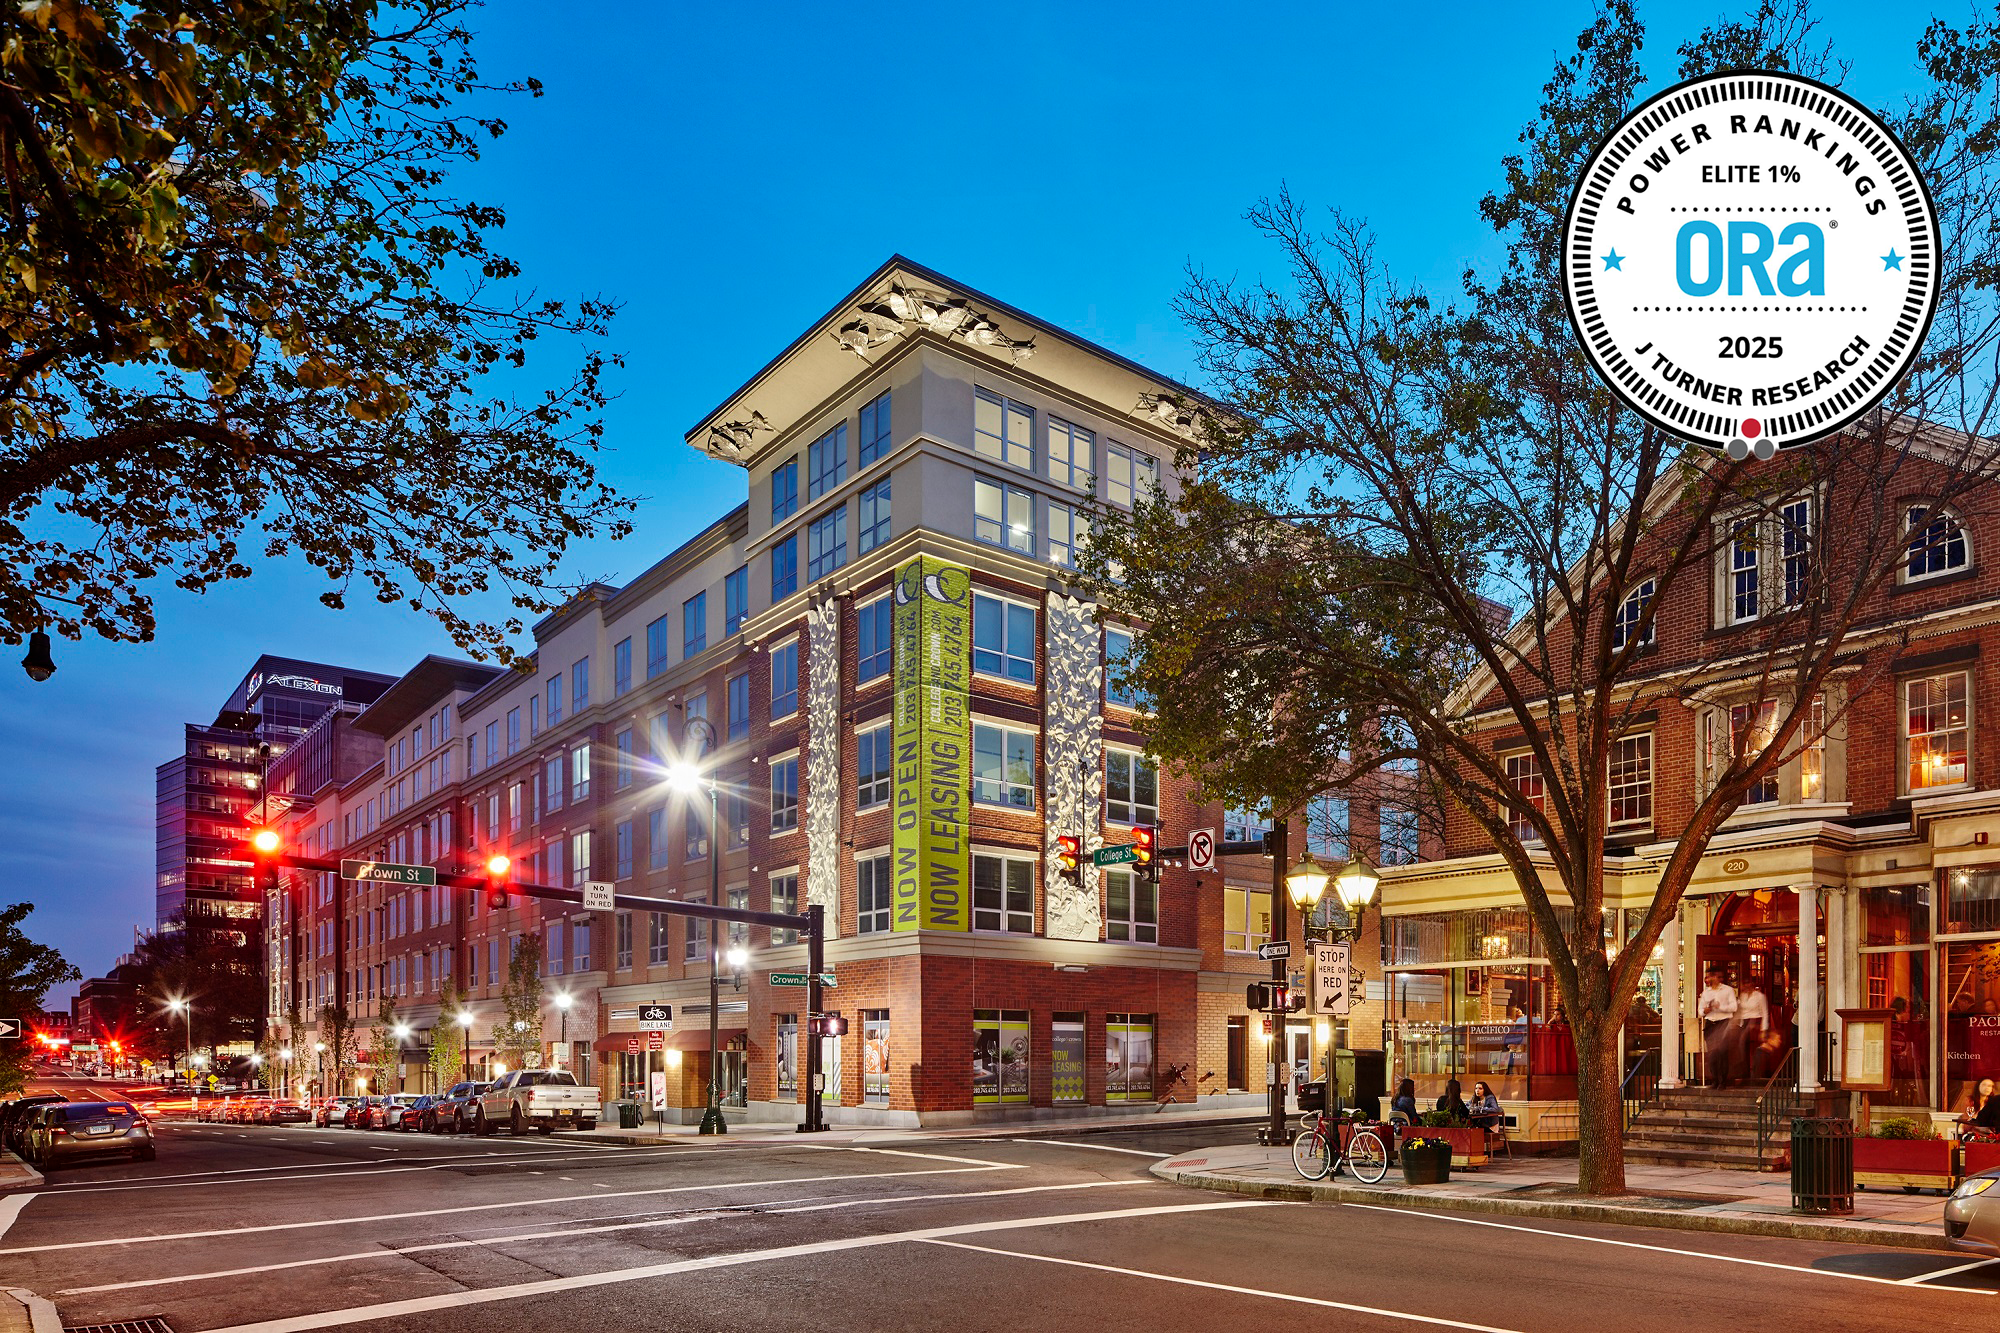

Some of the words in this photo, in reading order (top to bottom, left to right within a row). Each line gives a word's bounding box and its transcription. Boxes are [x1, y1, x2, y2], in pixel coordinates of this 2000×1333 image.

[905, 610, 917, 724] 203.745.4764
[930, 609, 942, 723] COLLEGEANDCROWN.COM
[943, 615, 963, 728] 203.745.4764
[897, 740, 917, 831] OPEN
[930, 741, 961, 855] LEASING
[1100, 850, 1123, 863] College
[1124, 846, 1132, 859] St
[359, 865, 402, 880] Crown
[406, 868, 420, 881] St
[1727, 861, 1745, 872] 220
[897, 847, 917, 923] NOW
[929, 862, 960, 926] NOW
[1267, 947, 1276, 955] ONE
[1276, 946, 1287, 954] WAY
[1319, 950, 1345, 963] STOP
[1318, 965, 1335, 973] HERE
[1337, 966, 1346, 974] ON
[771, 975, 799, 984] Crown
[1323, 976, 1342, 989] RED
[640, 1021, 655, 1029] BIKE
[656, 1021, 672, 1029] LANE
[1052, 1050, 1068, 1060] NOW
[1947, 1051, 1981, 1060] Kitchen
[1052, 1062, 1082, 1072] LEASING
